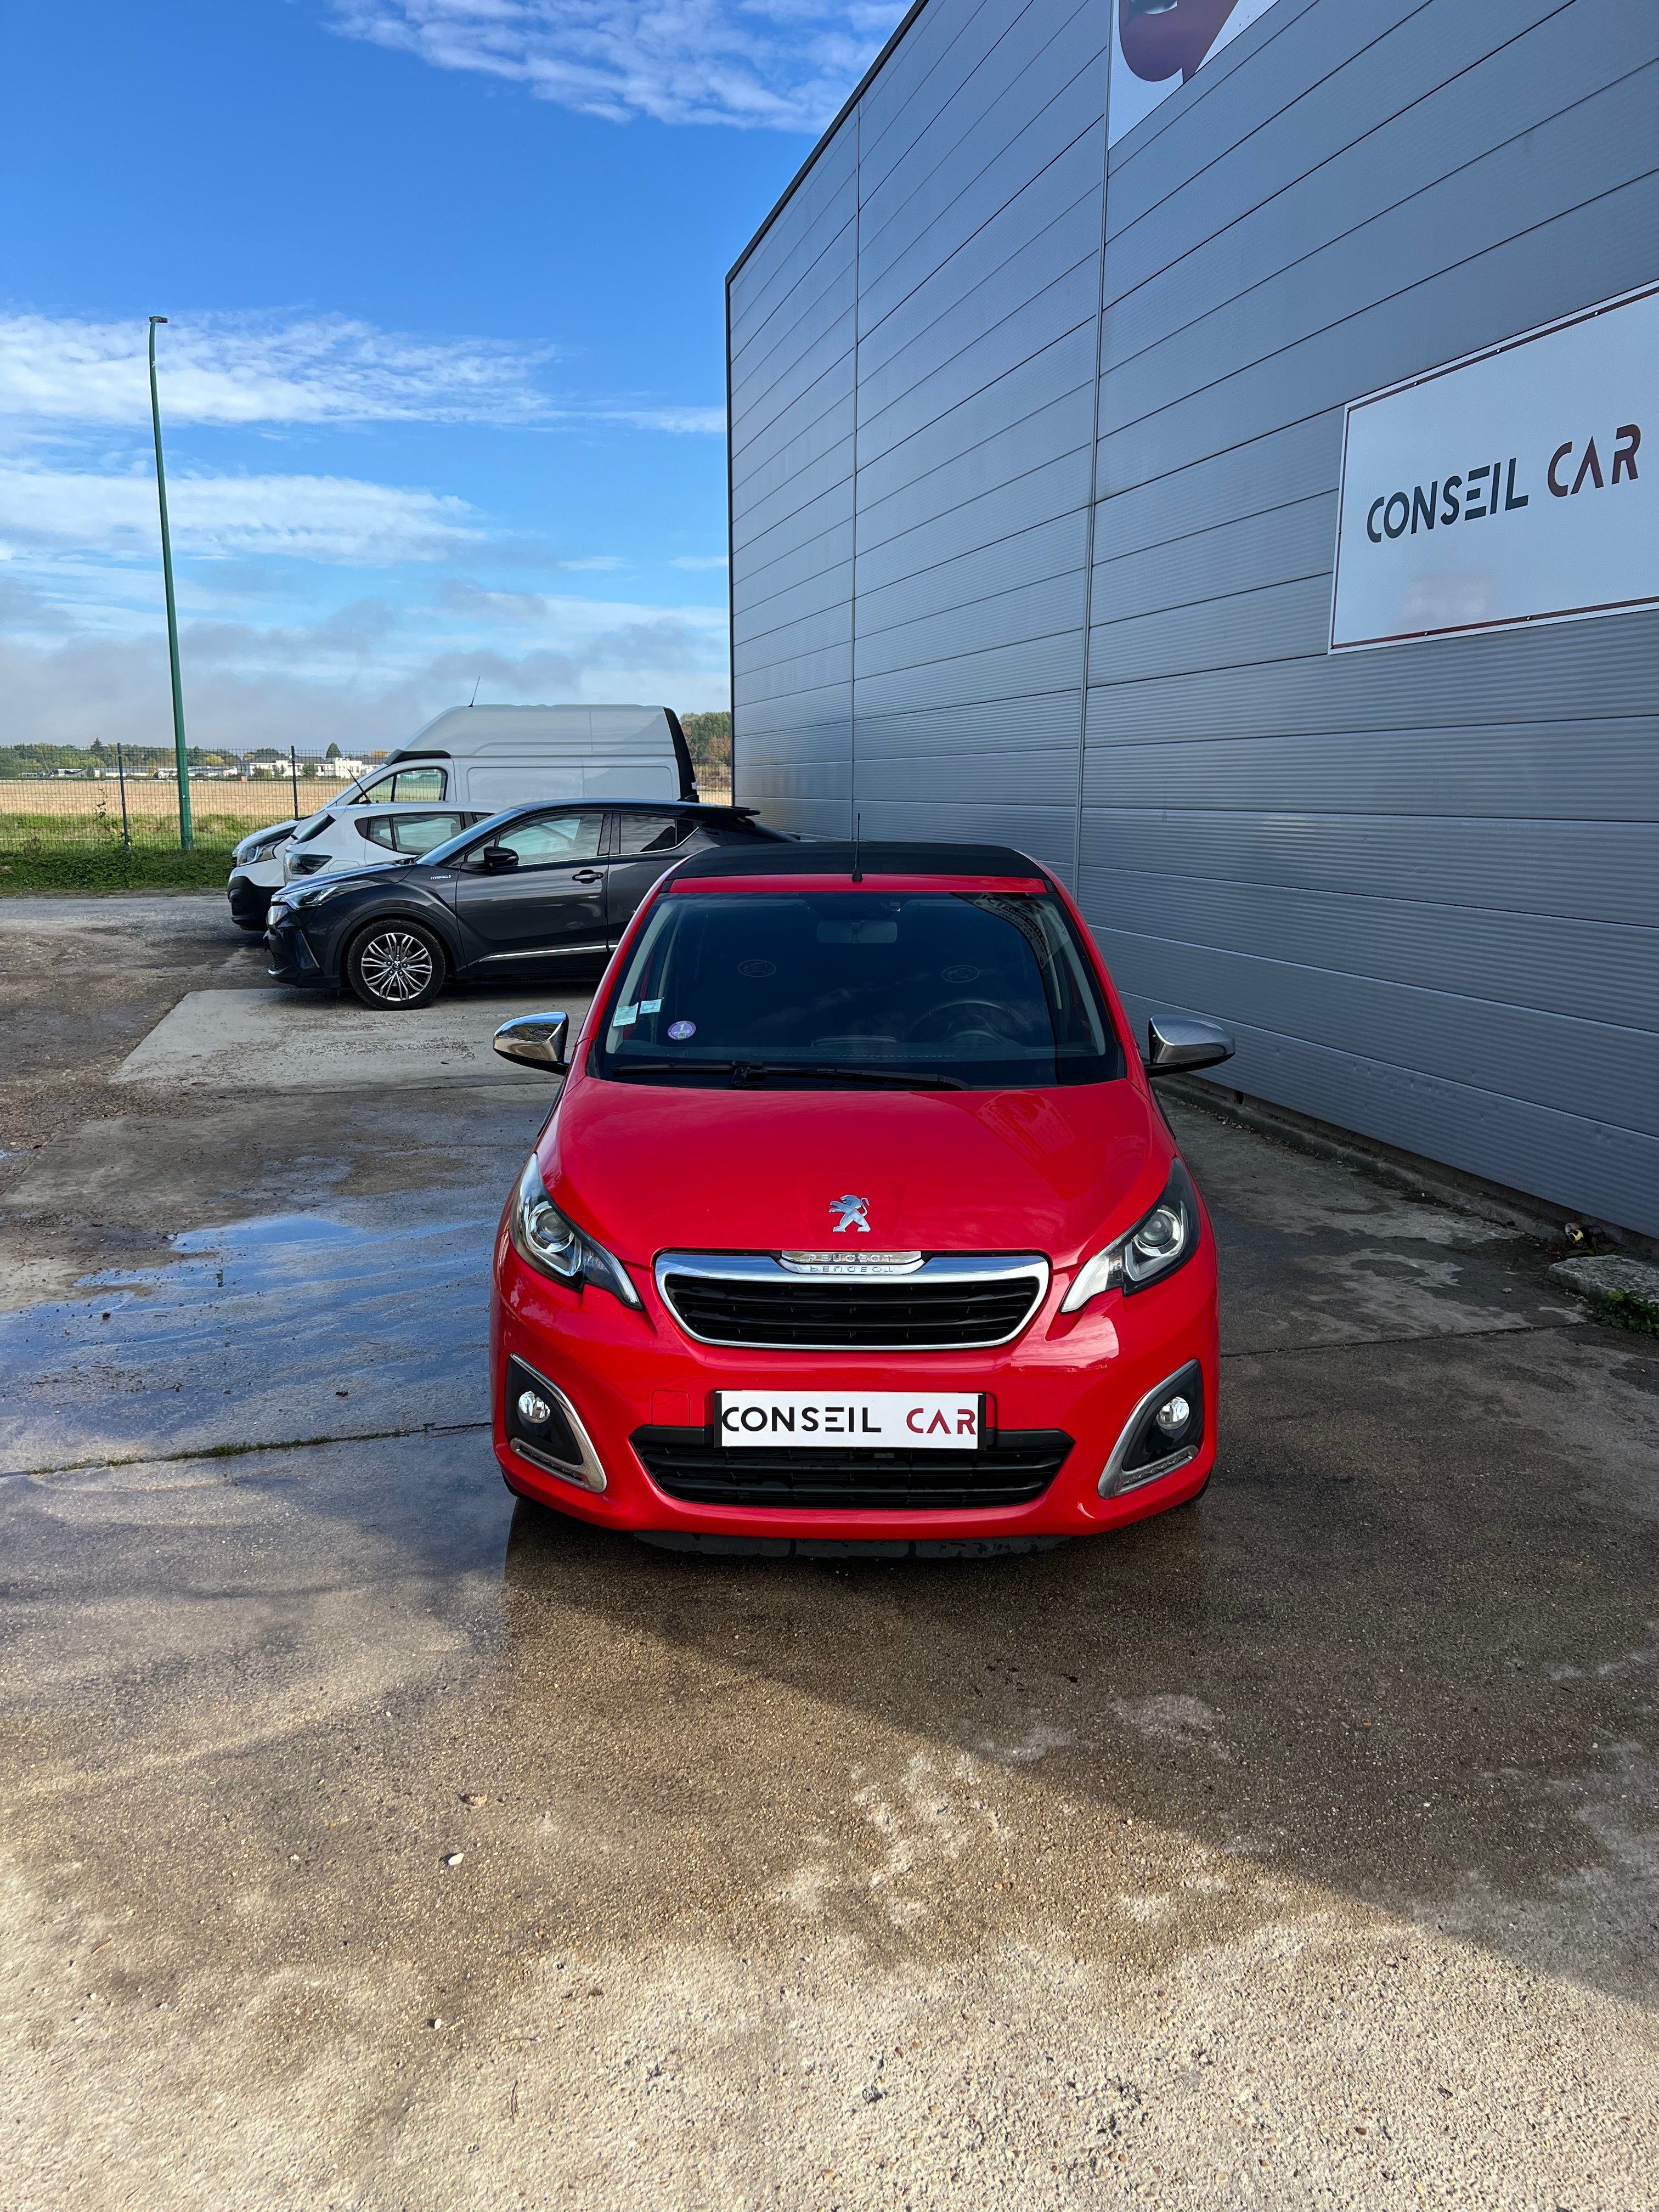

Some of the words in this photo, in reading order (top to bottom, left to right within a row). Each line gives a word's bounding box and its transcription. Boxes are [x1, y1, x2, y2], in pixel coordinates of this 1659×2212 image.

[1367, 458, 1529, 543] CONSEIL
[1547, 424, 1641, 498] CAR
[809, 1254, 893, 1262] PEUGEOT
[722, 1406, 882, 1433] CONSEIL
[906, 1408, 977, 1435] CAR
